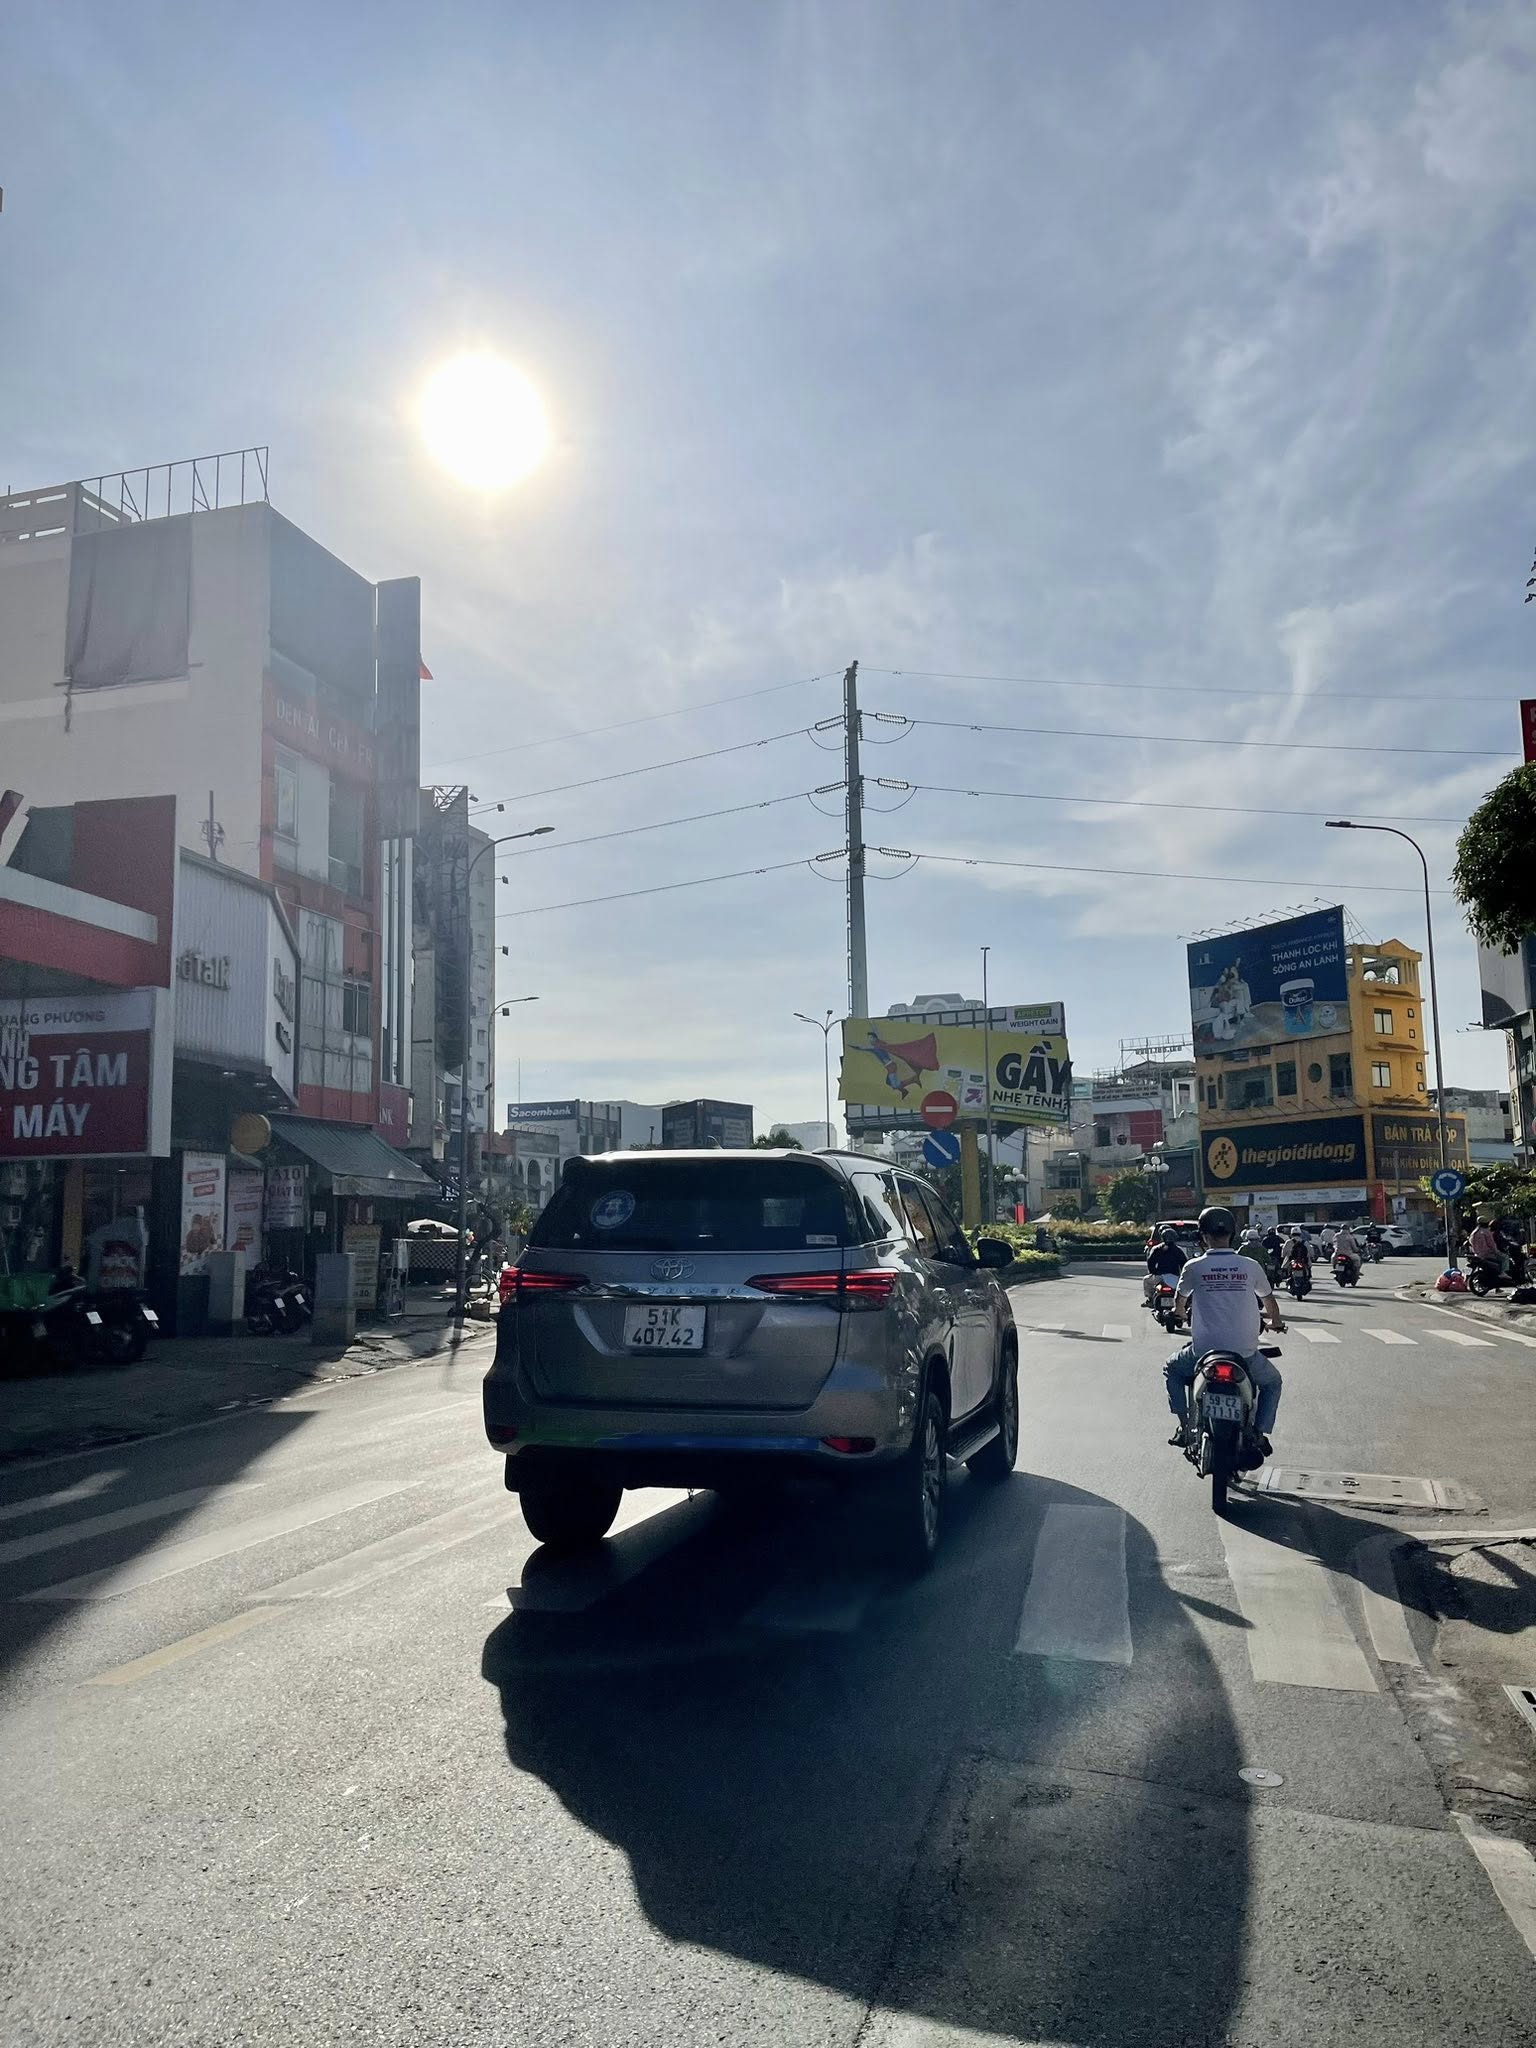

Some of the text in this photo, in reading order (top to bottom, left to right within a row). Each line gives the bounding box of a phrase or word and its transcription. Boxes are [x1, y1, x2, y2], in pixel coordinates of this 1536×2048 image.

[329, 727, 373, 768] CENER
[1271, 948, 1301, 962] THANH
[1299, 959, 1312, 970] AN
[1010, 1018, 1058, 1028] WEIGHT GAIN
[50, 1048, 128, 1088] TÂM
[996, 1041, 1073, 1095] GẦY
[993, 1090, 1021, 1107] NHẸ
[13, 1098, 91, 1138] MÁY
[510, 1105, 572, 1118] Sacombank
[1242, 1142, 1355, 1168] thegioididong
[648, 1308, 680, 1326] 51K
[632, 1327, 694, 1346] 407.42
